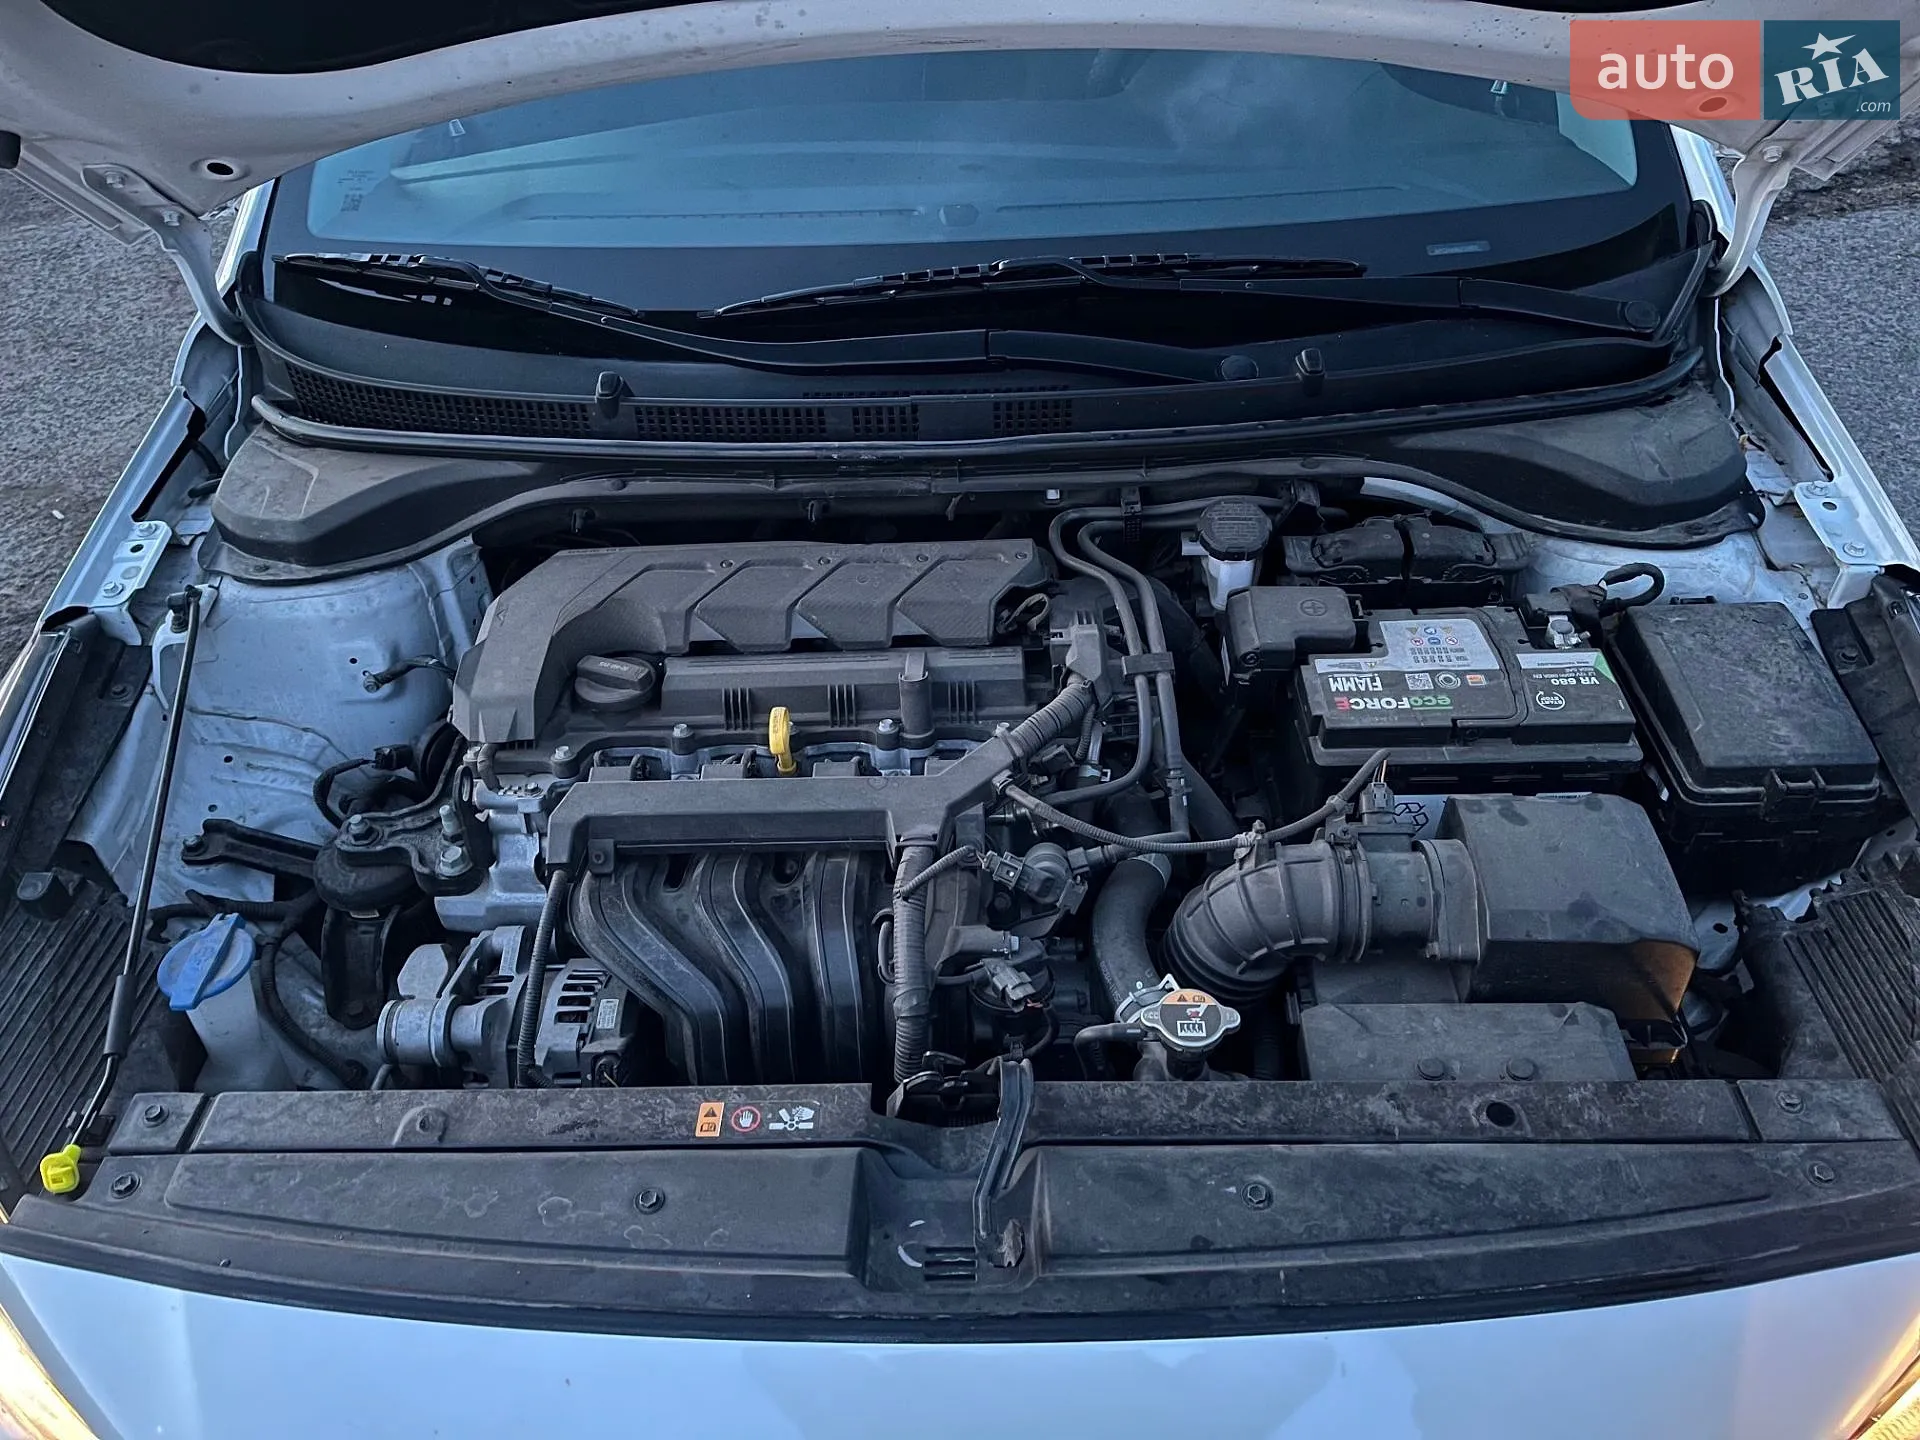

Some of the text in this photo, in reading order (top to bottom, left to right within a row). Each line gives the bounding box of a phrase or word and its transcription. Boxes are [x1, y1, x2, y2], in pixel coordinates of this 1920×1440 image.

[1327, 676, 1383, 692] FIAMM
[1551, 677, 1600, 686] VR 680
[1334, 695, 1452, 710] ecoFORCE
